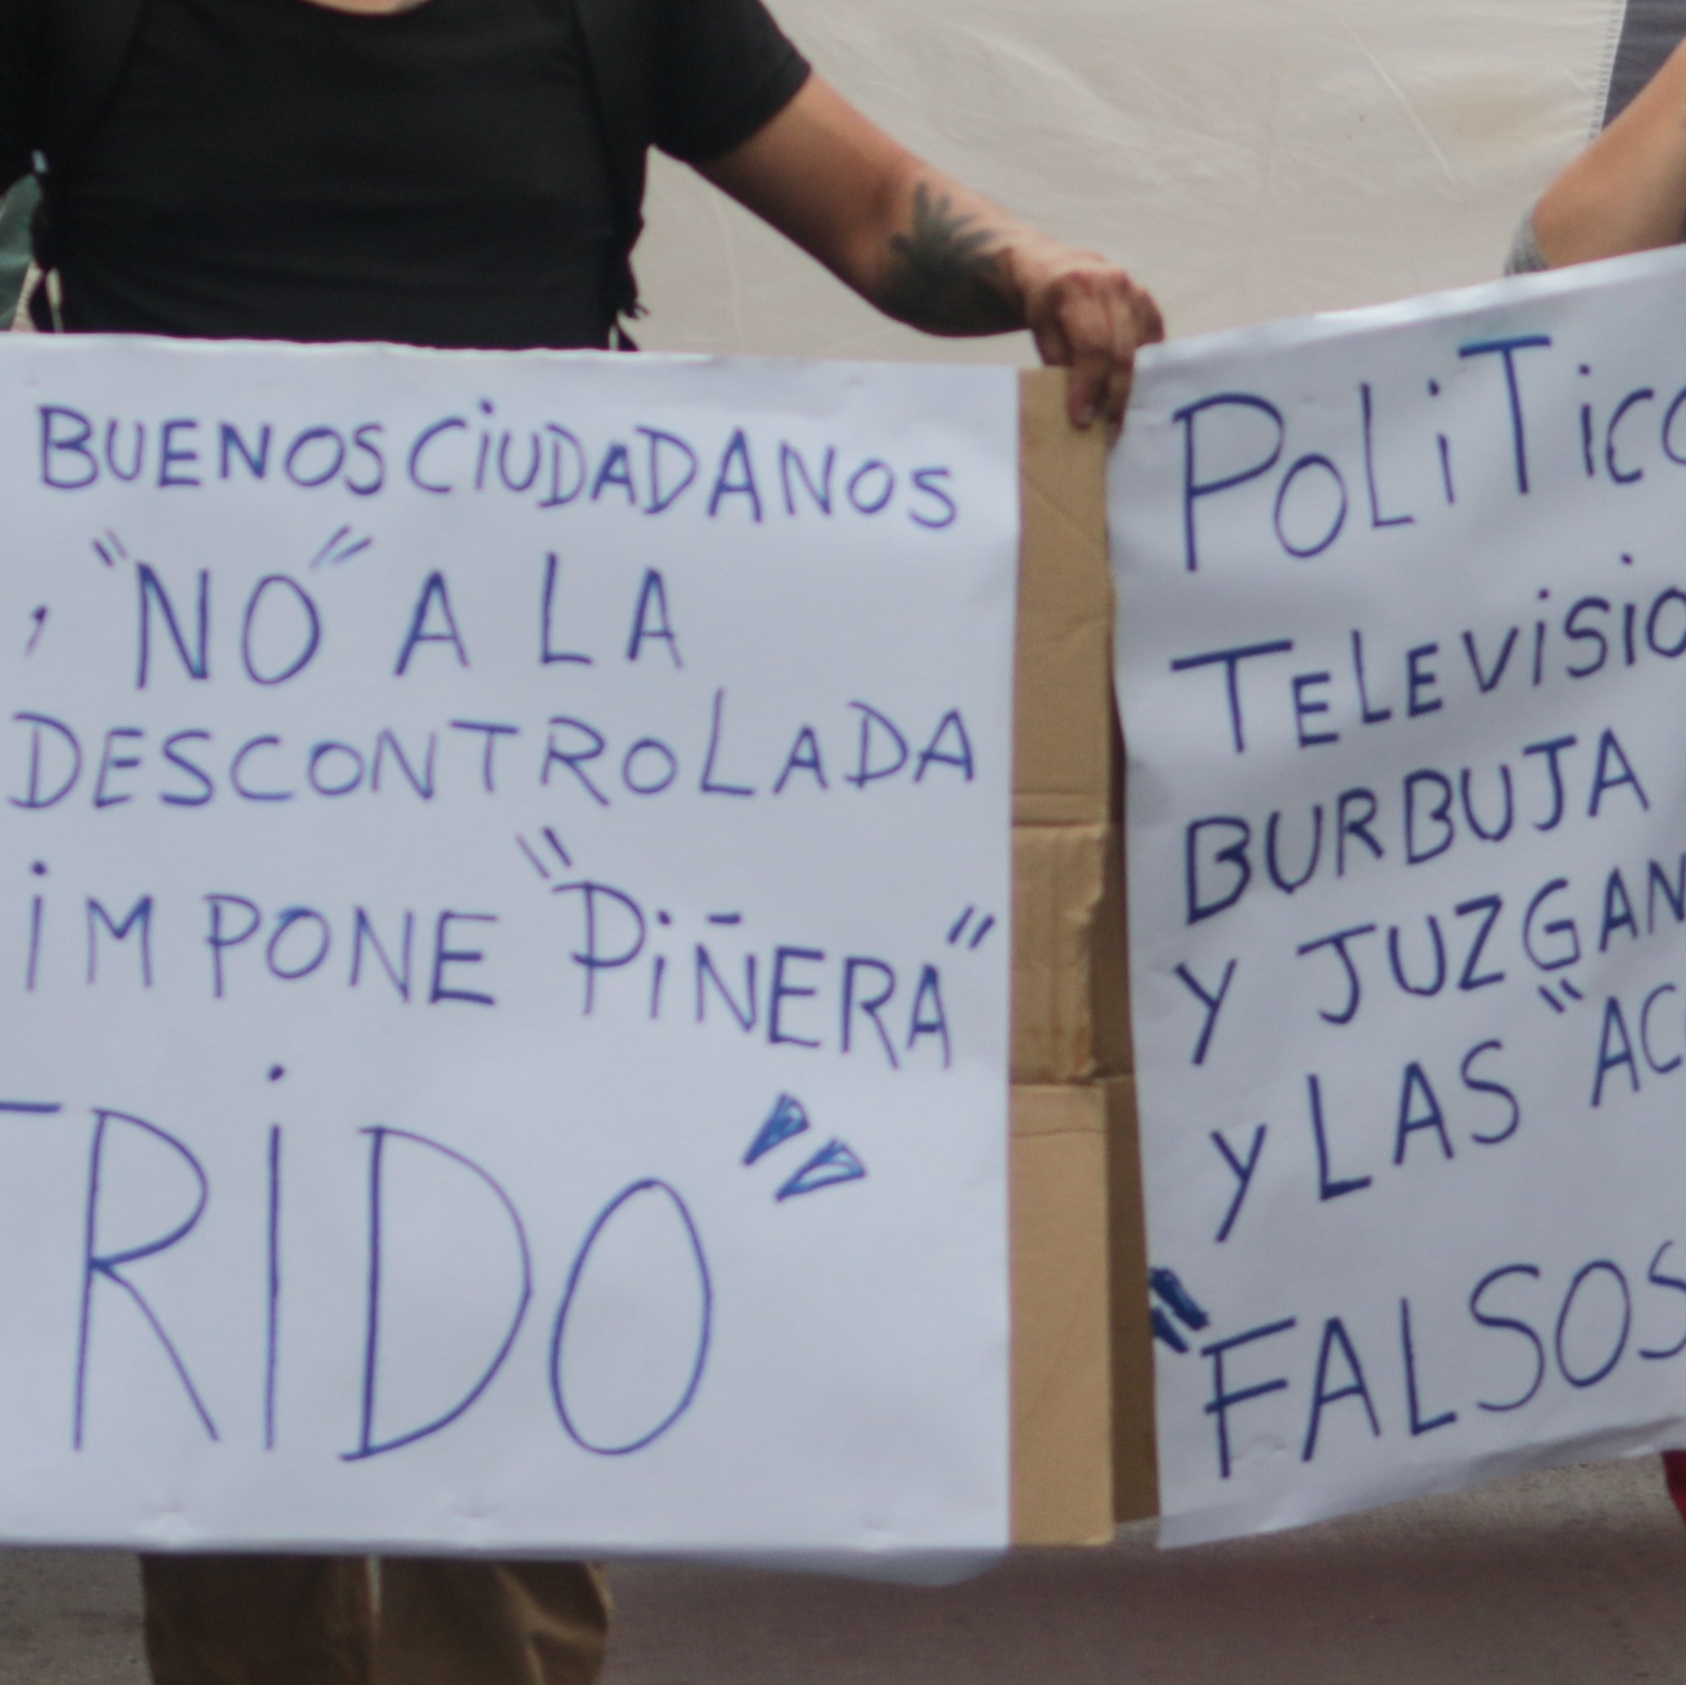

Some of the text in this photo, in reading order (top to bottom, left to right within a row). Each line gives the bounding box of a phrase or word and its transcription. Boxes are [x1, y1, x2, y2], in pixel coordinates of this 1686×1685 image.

[392, 570, 470, 678] A
[538, 551, 685, 670] LA
[1185, 727, 1650, 926] BURBUJA
[1307, 1039, 1521, 1202] LAS
